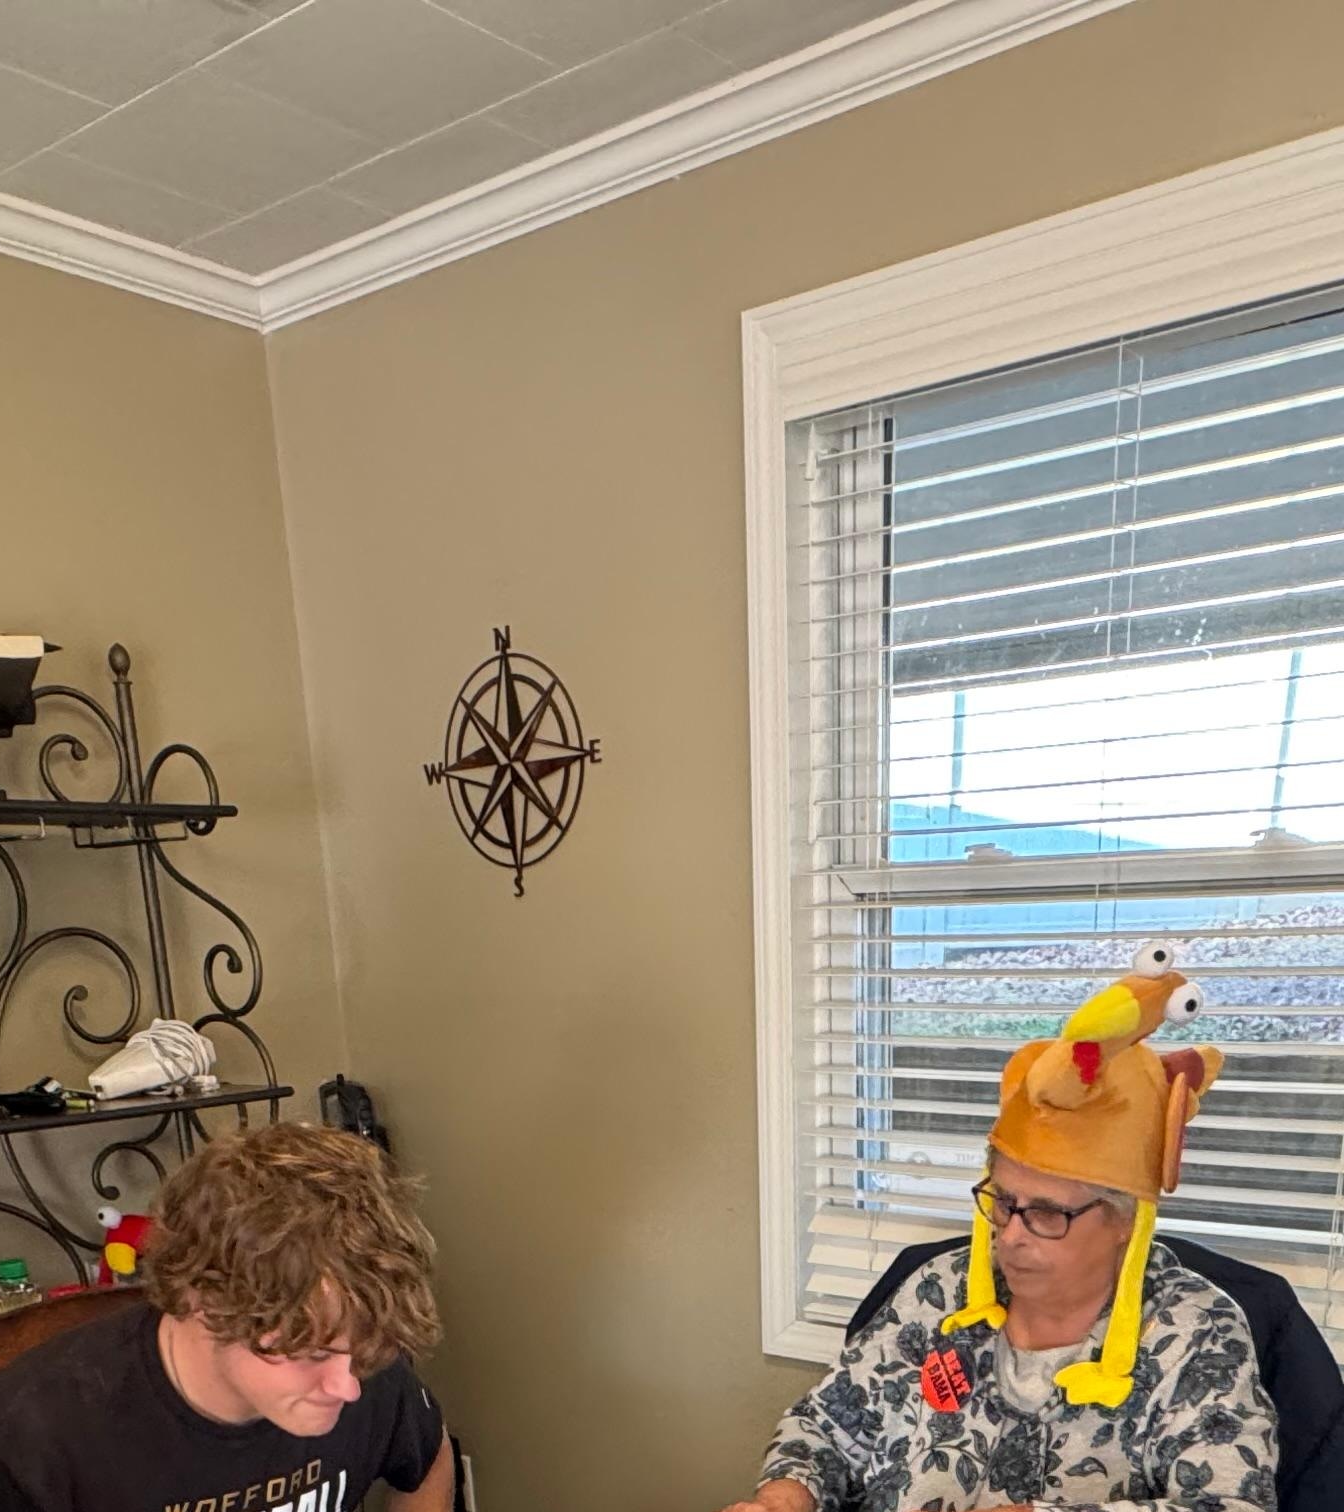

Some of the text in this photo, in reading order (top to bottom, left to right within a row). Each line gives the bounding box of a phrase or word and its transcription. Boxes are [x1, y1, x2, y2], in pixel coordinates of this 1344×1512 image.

[492, 625, 512, 652] N
[587, 739, 603, 764] E
[423, 762, 445, 786] W
[514, 877, 525, 898] S
[928, 1363, 951, 1404] BAMA
[943, 1349, 971, 1395] BEAT
